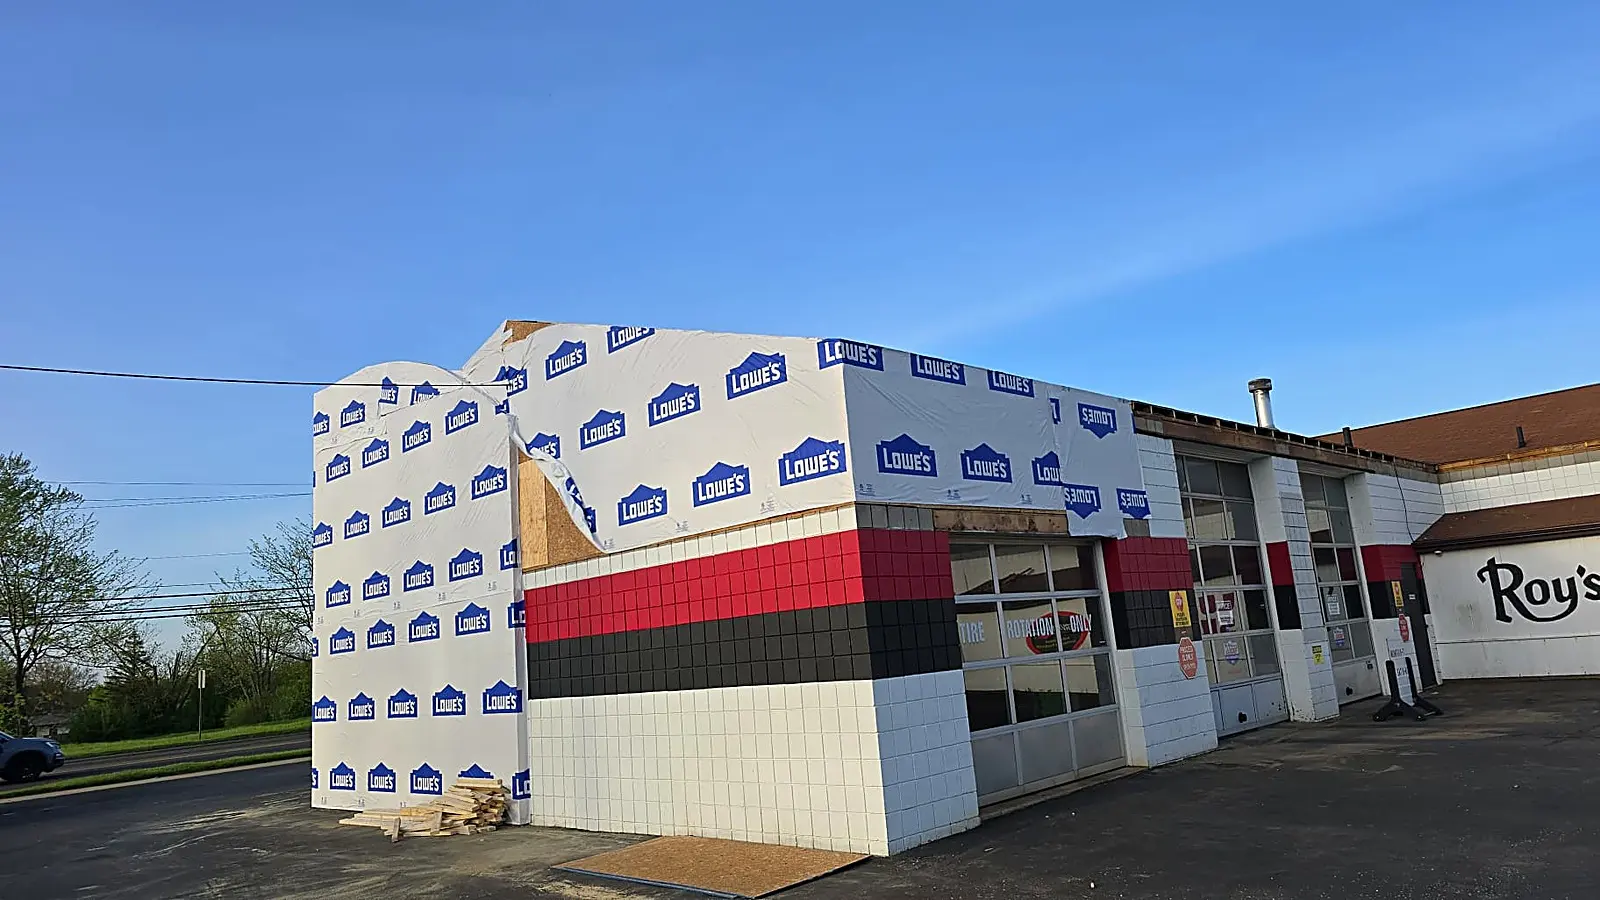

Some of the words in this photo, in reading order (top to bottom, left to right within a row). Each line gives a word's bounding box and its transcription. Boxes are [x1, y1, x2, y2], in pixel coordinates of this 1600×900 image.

[611, 327, 650, 348] LOWES
[549, 348, 583, 375] LOWE'S
[823, 340, 877, 365] LOWE'S
[732, 361, 781, 394] LOWE'S
[916, 355, 960, 381] LOWE'S
[993, 371, 1030, 393] LOWES
[343, 408, 364, 425] LOWE'S
[653, 392, 696, 421] LOWE'S
[448, 408, 477, 431] LOWE'S
[1083, 407, 1112, 428] LOWE'S
[405, 428, 429, 449] LOWE'S
[584, 419, 622, 444] LOWE'S
[364, 445, 388, 465] LOWE'S
[785, 449, 840, 480] LOWE'S
[882, 447, 932, 471] LOWE'S
[328, 461, 349, 478] LOWE'S
[965, 456, 1007, 479] LOWE'S
[474, 474, 504, 495] LOWE'S
[698, 473, 745, 501] LOWE'S
[427, 491, 453, 510] LOWE'S
[622, 495, 663, 520] LOWE'S
[385, 506, 408, 525] LOWE'S
[346, 520, 368, 536] LOWE'S
[452, 557, 481, 577] LOWE'S
[365, 579, 388, 597] LOWE'S
[406, 569, 432, 588] LOWE'S
[328, 589, 349, 605] LOWE'S
[1477, 557, 1600, 623] Roy's
[411, 620, 438, 639] LOWE'S
[458, 612, 488, 632] LOWE'S
[959, 620, 985, 644] TIRE
[1006, 617, 1054, 640] ROTATION
[1070, 613, 1092, 632] ONLY
[332, 636, 353, 651] LOWE'S
[369, 629, 393, 646] LOWE'S
[350, 703, 373, 718] LOWE'S
[390, 701, 415, 715] LOWE'S
[435, 697, 463, 713] LOWE'S
[486, 693, 517, 710] LOWE'S
[314, 705, 335, 720] LOWE'S
[332, 774, 353, 788] LOWE'S
[370, 774, 394, 790] LOWE'S
[413, 775, 440, 792] LOWE'S
